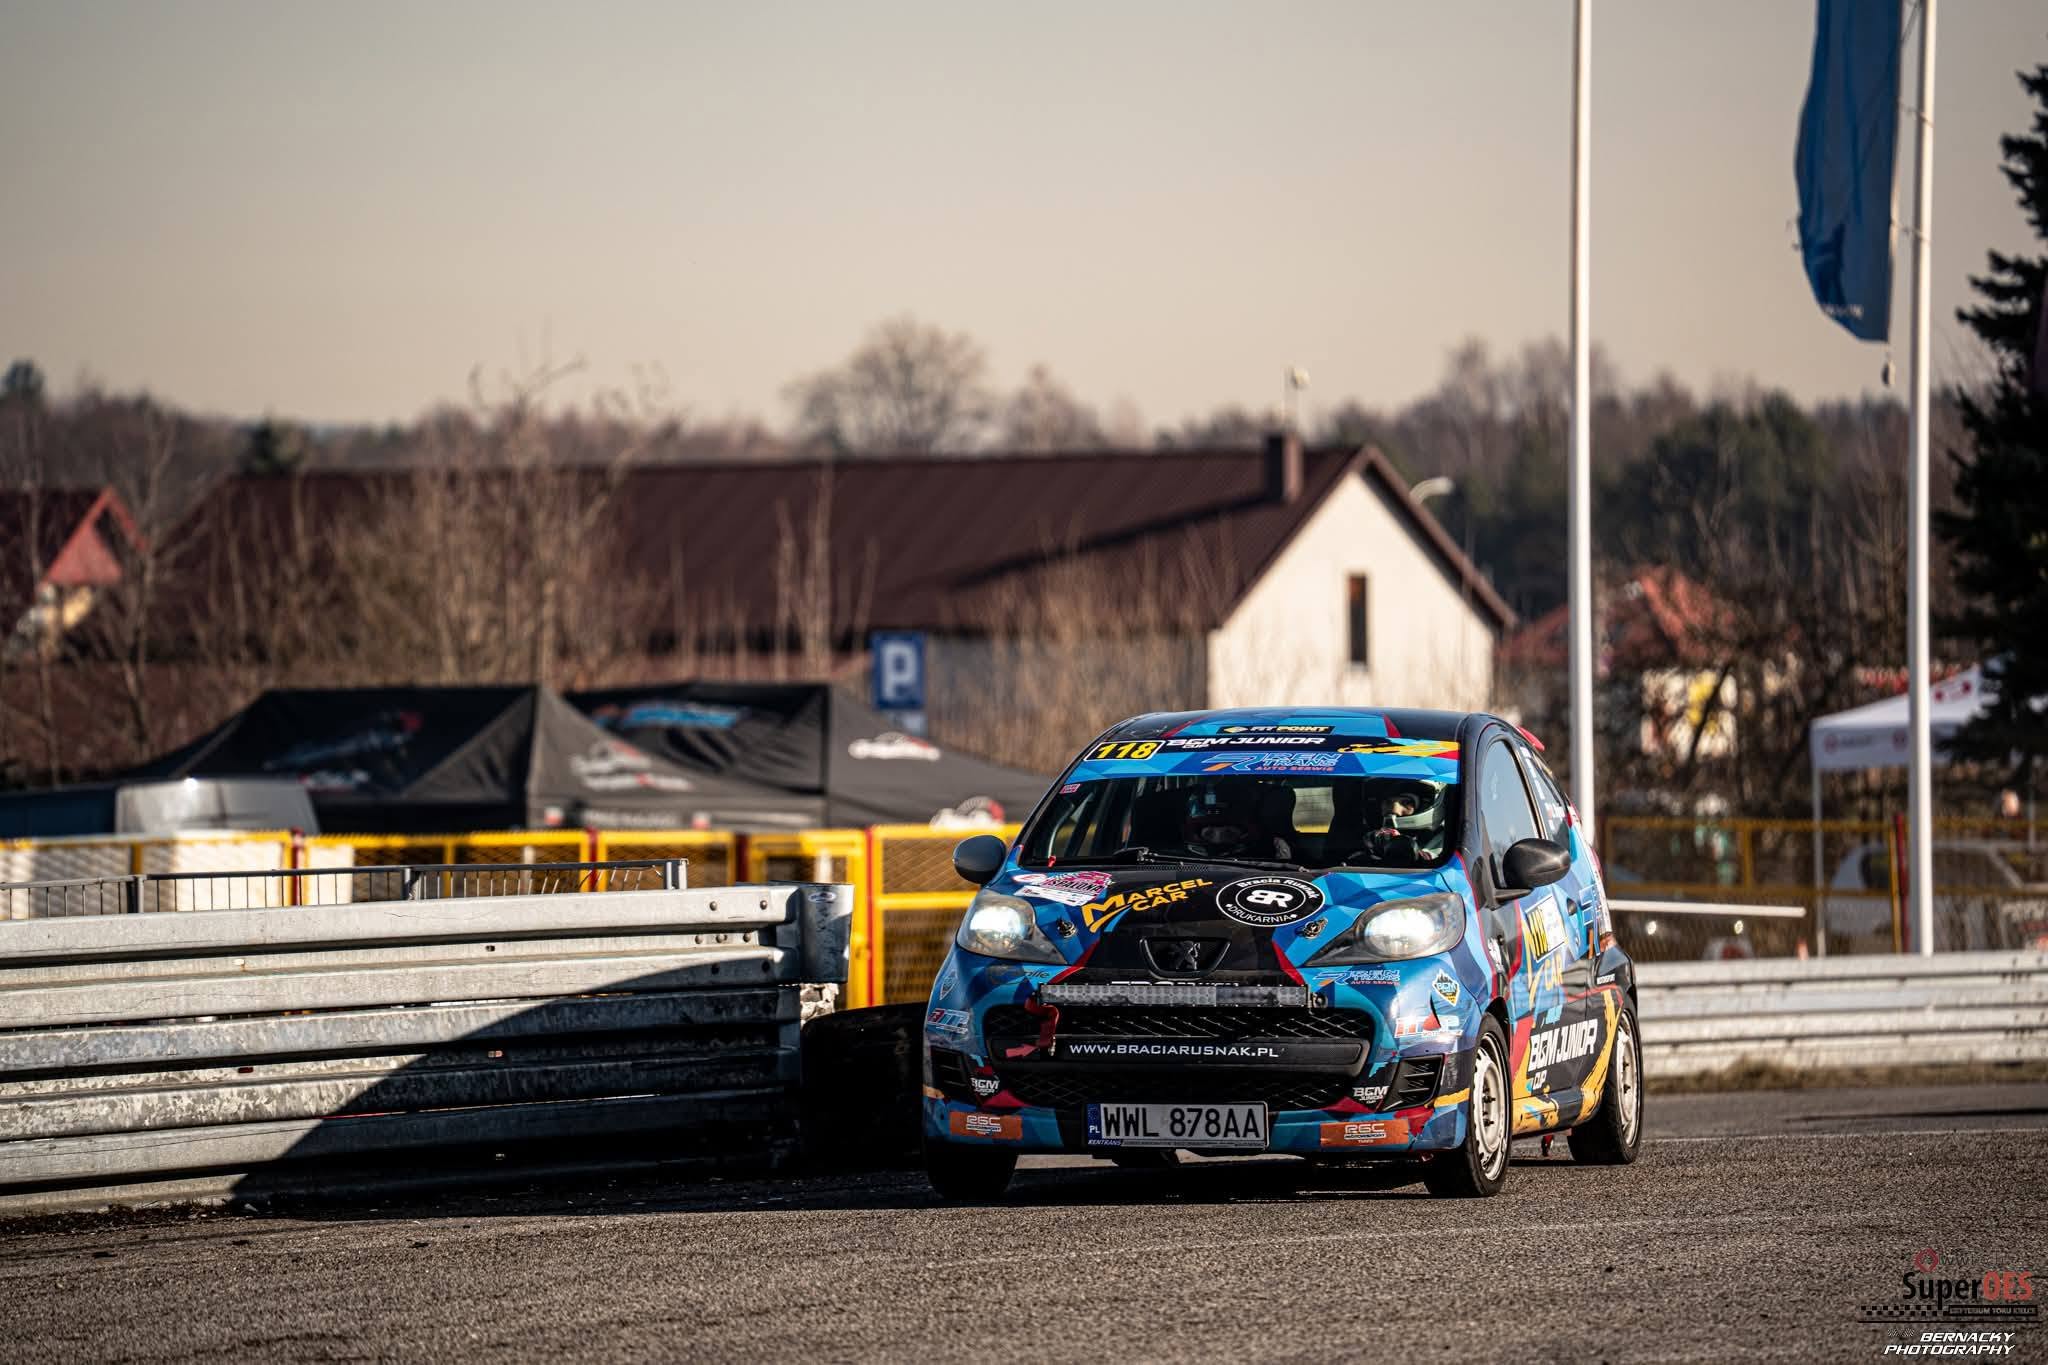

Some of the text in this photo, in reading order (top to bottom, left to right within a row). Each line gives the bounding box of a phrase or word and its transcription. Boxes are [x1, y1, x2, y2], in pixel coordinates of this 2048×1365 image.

[881, 641, 916, 699] P
[1167, 737, 1326, 746] BGM JUNIOR
[1096, 742, 1158, 759] 118
[1264, 752, 1344, 761] REN
[1263, 759, 1338, 767] TRANS
[1081, 878, 1213, 931] MARCEL
[1132, 890, 1190, 911] CAR
[1228, 905, 1293, 923] DRUKARNIA
[1069, 1044, 1280, 1058] WWW.BRACIARUSNAK.PL
[1527, 1018, 1598, 1072] BGM JUNIOR
[1532, 1070, 1547, 1090] CUP
[1352, 1086, 1390, 1097] BGM
[1089, 1125, 1101, 1134] PL
[1103, 1107, 1261, 1138] WWL 878AA
